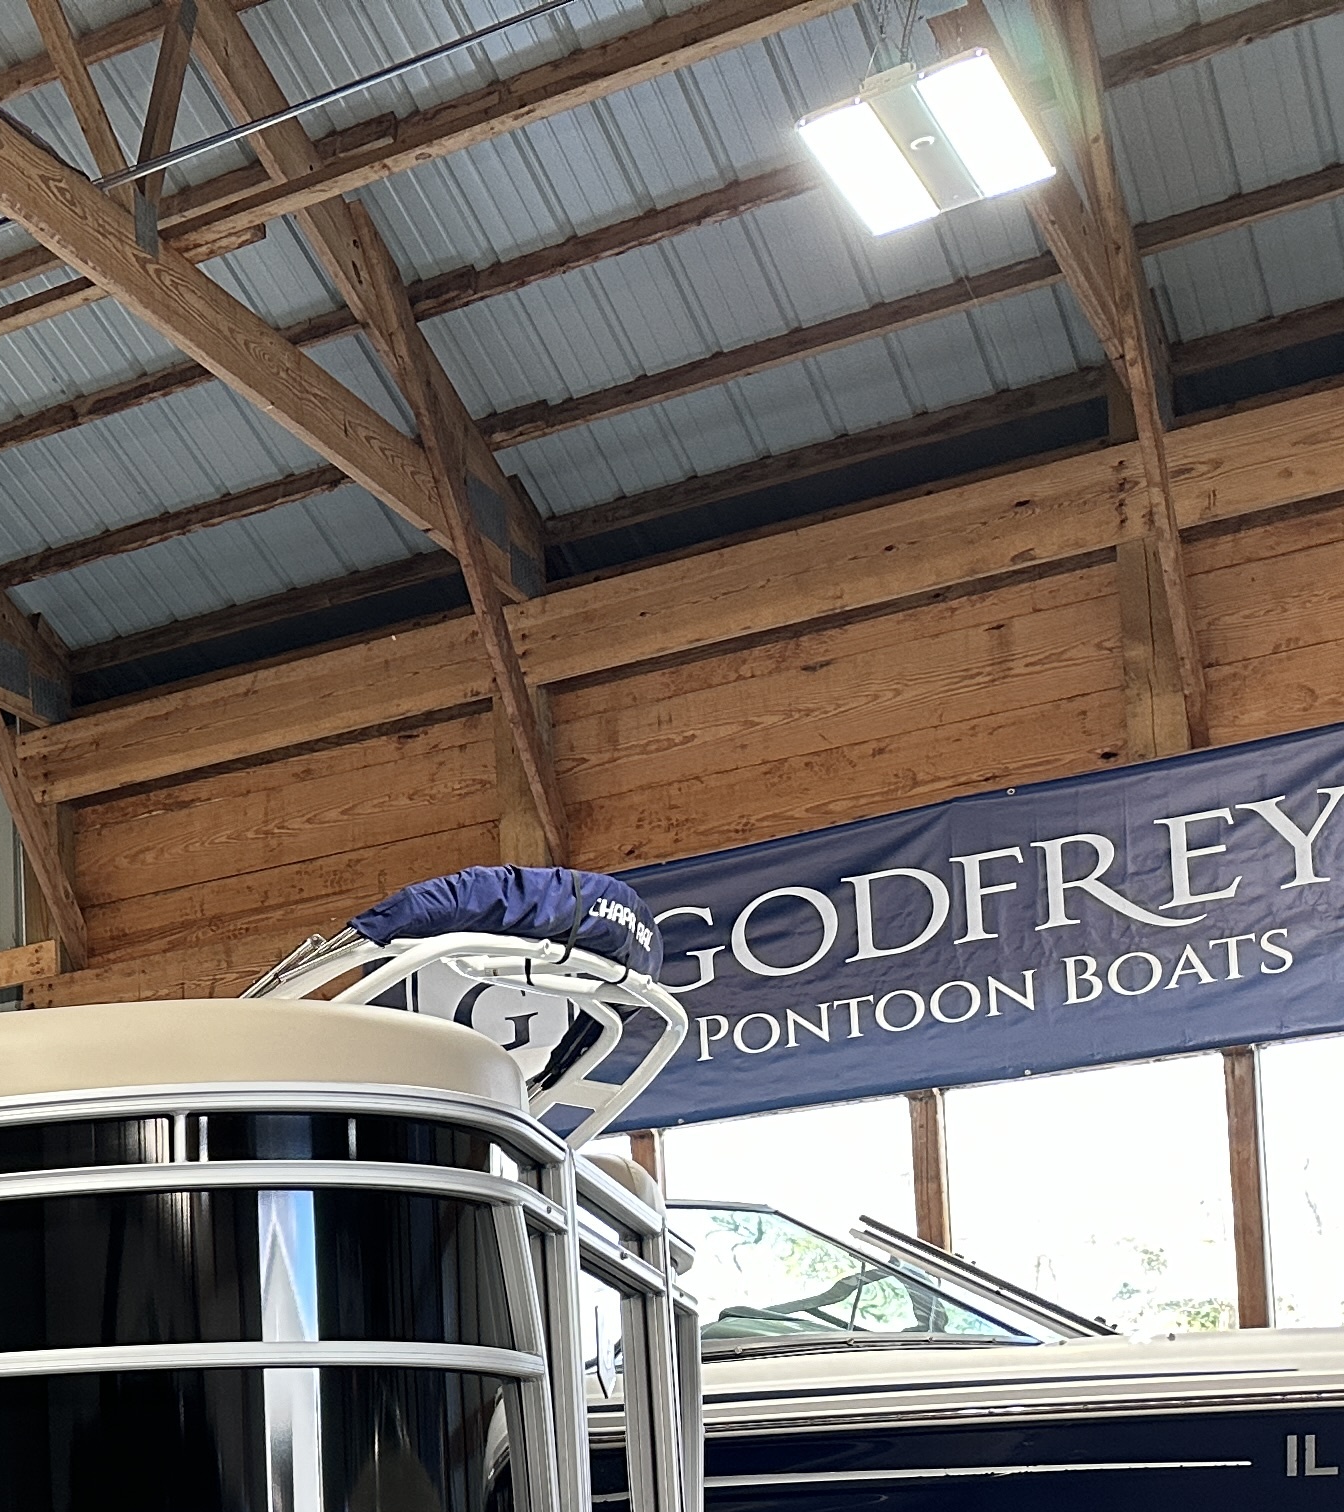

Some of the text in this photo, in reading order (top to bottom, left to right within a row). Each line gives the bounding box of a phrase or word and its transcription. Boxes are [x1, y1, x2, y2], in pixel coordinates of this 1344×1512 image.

[653, 785, 1344, 993] GODFREY
[695, 927, 1294, 1062] PONTOON BOATS
[1286, 1434, 1339, 1477] IL
